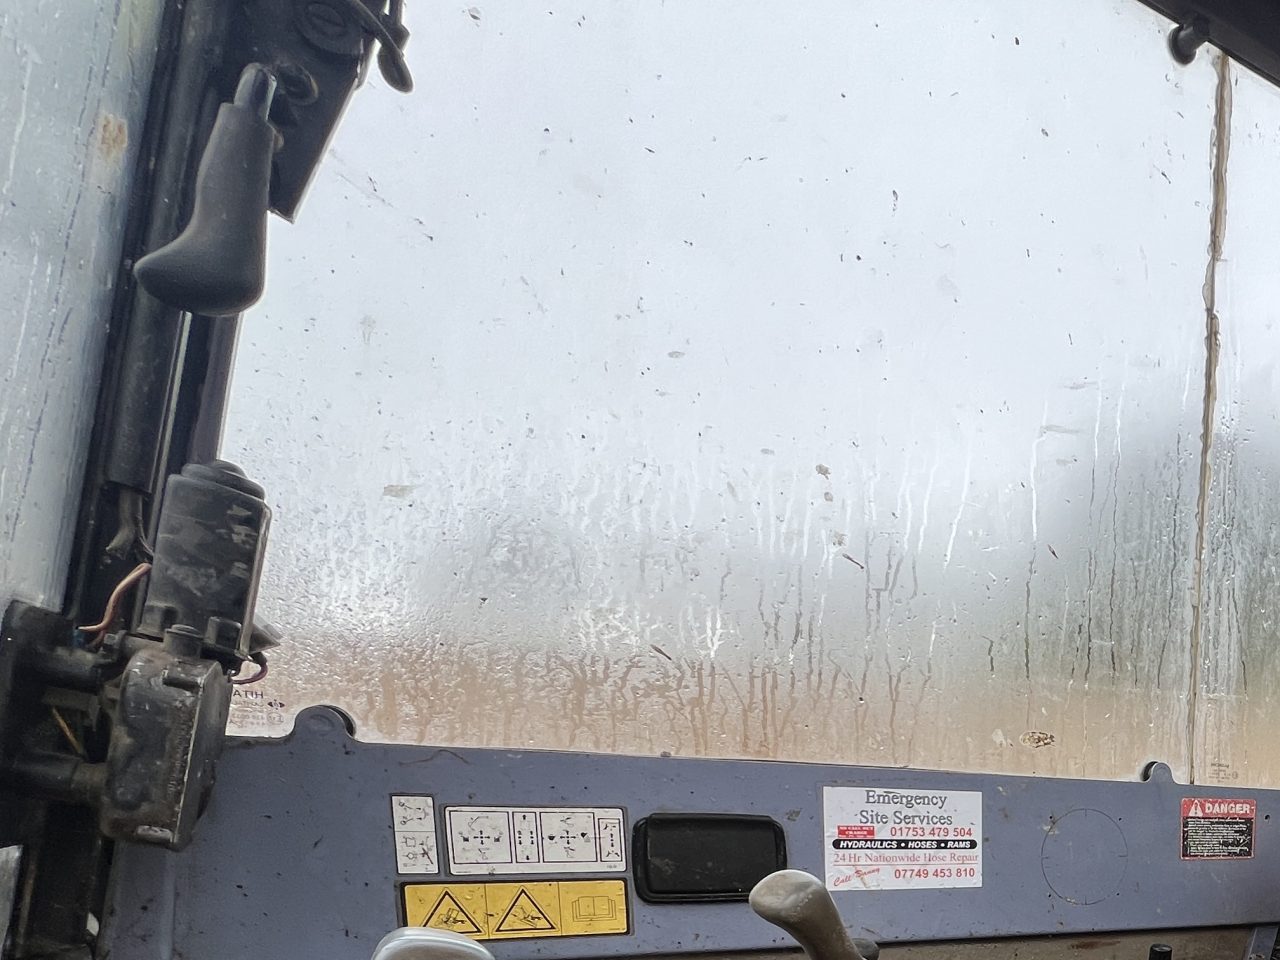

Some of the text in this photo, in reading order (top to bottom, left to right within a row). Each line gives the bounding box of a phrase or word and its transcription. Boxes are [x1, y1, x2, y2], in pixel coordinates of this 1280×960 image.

[865, 790, 947, 809] Emergency
[1205, 803, 1250, 814] DANGER
[859, 810, 953, 825] Site Services
[890, 826, 972, 836] 01753 479 504
[839, 840, 971, 848] HYDRAULICS HOSES RAMS
[834, 853, 978, 863] 24 Hr Nationwide Hose Repair
[894, 868, 975, 878] 07749 453 810
[833, 875, 851, 886] Call
